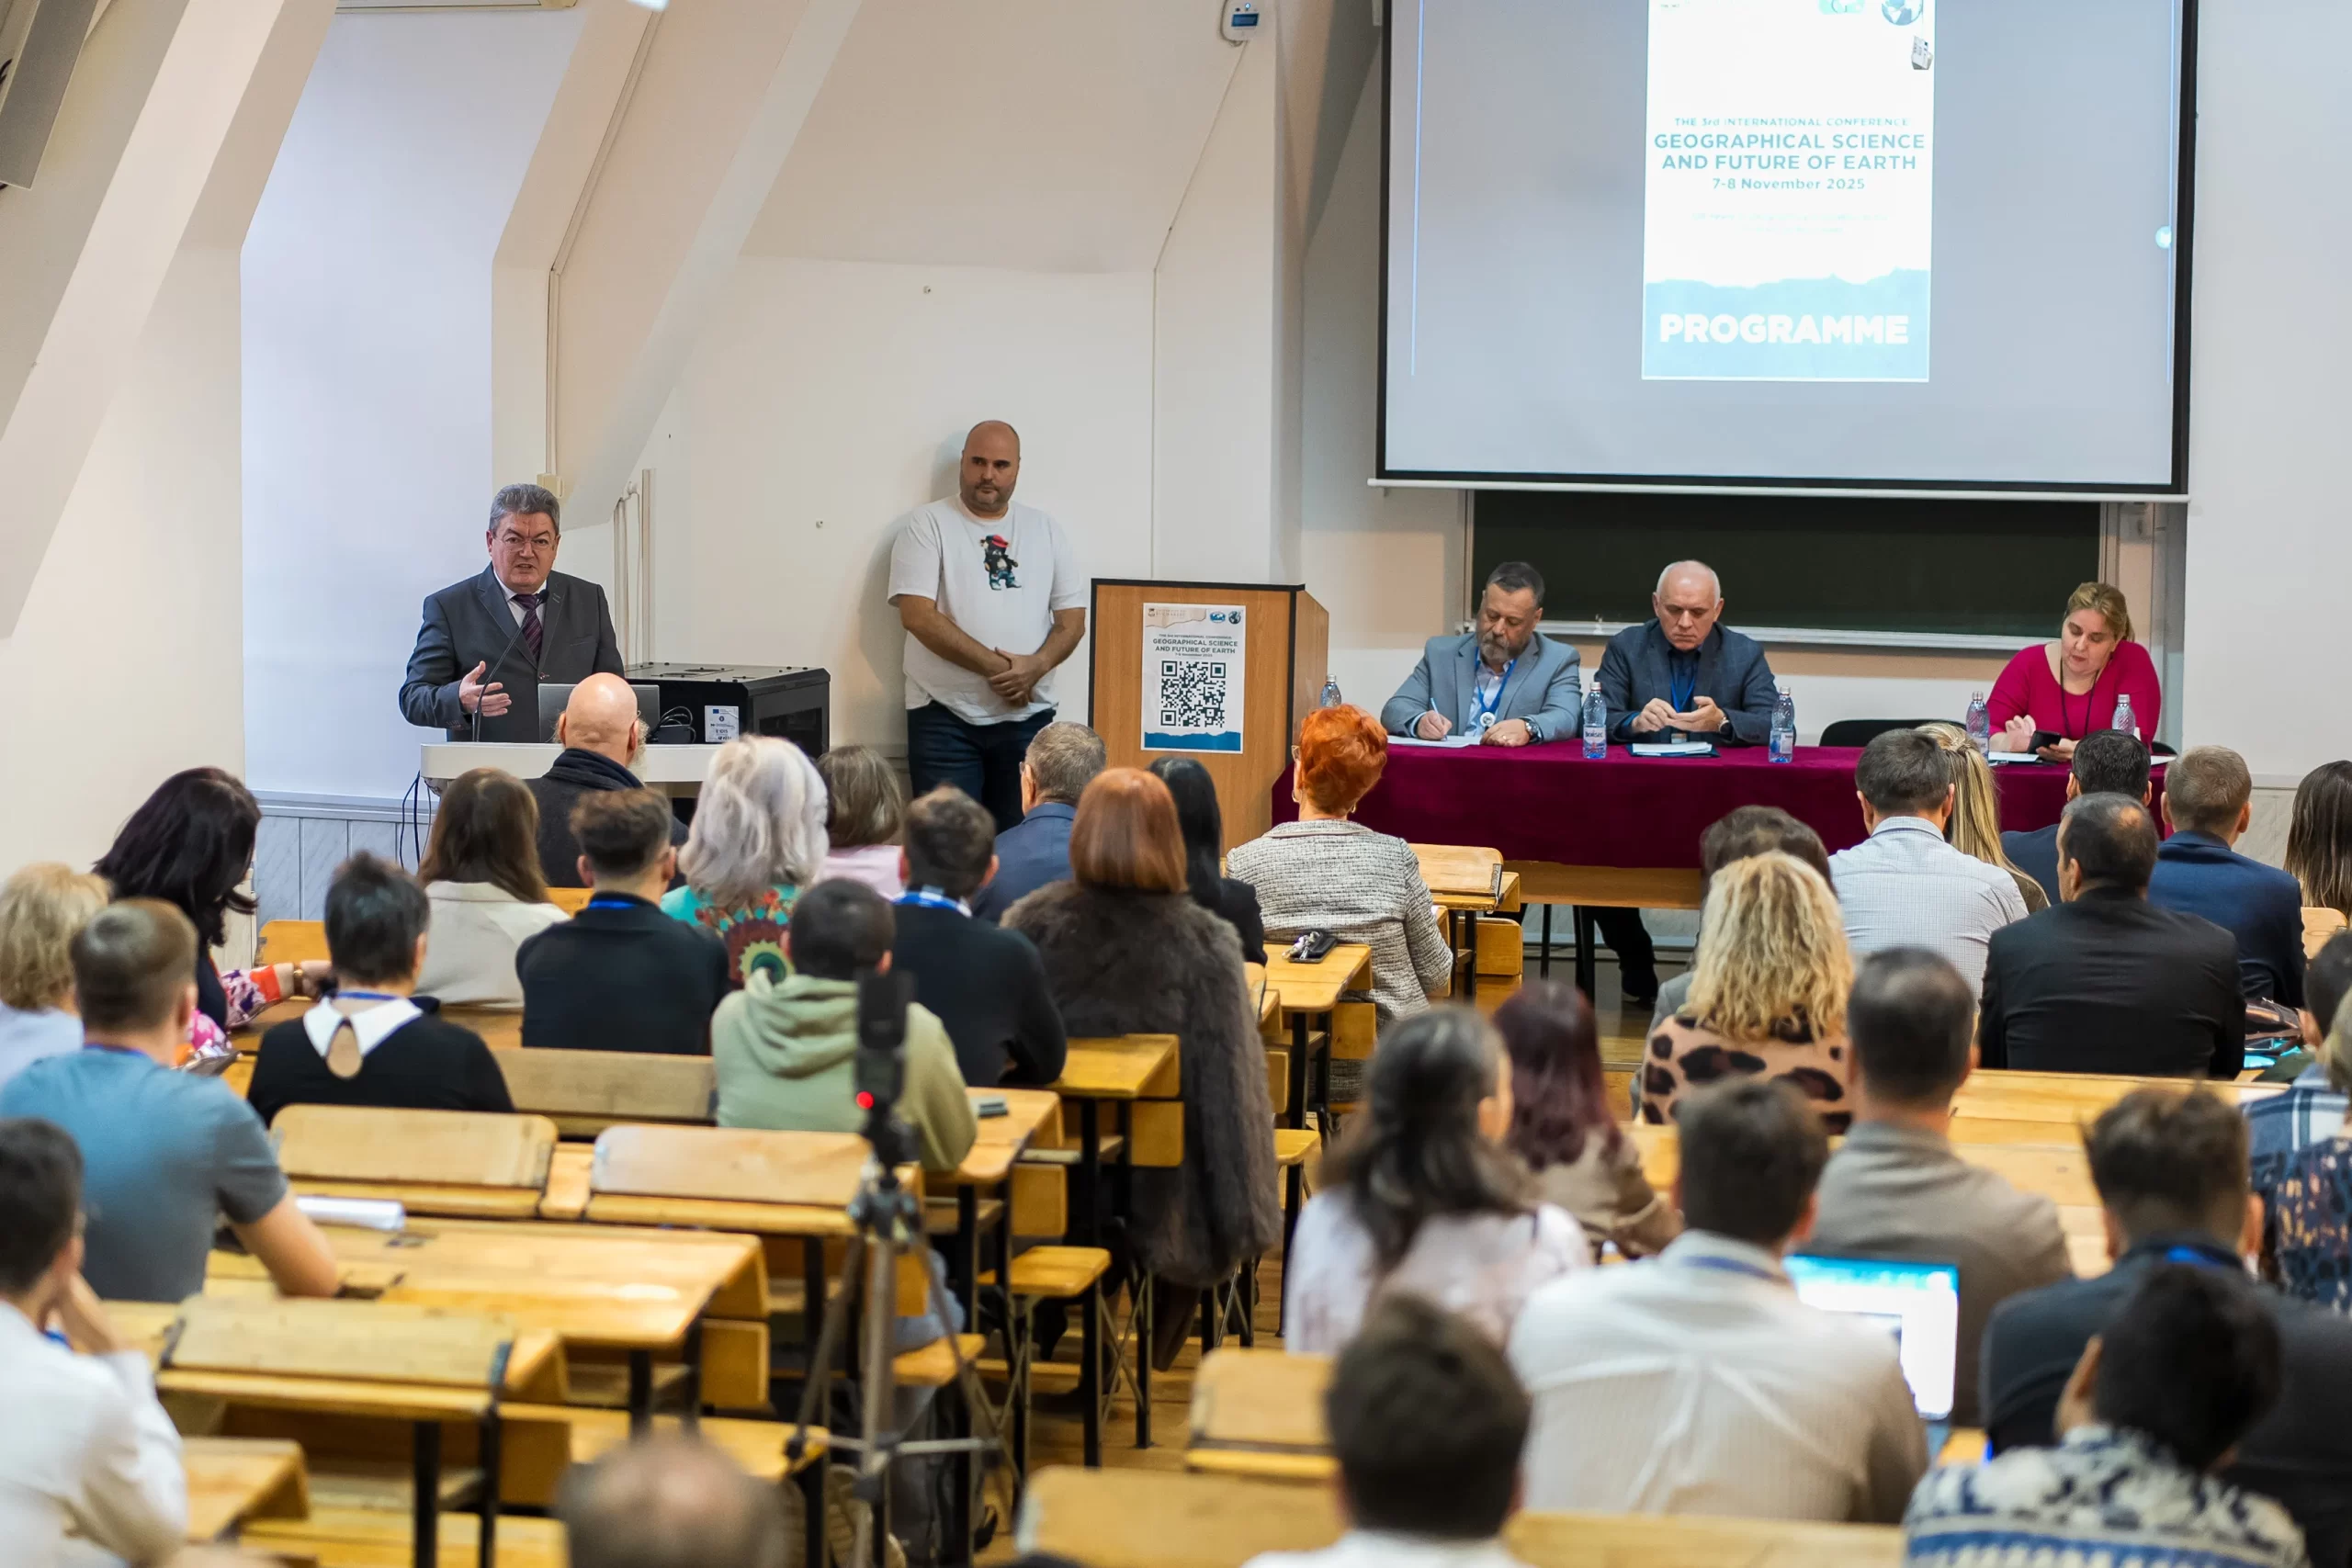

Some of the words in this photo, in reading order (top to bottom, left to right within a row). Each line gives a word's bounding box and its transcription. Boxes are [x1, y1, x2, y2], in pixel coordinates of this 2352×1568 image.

[1675, 118, 1697, 127] THE
[1702, 118, 1720, 127] 3rd
[1724, 118, 1822, 127] INTERNATIONAL
[1826, 118, 1910, 127] CONFERENCE
[1654, 133, 1825, 150] GEOGRAPHICAL
[1832, 133, 1925, 150] SCIENCE
[1662, 154, 1708, 170] AND
[1715, 154, 1800, 170] FUTURE
[1807, 154, 1836, 170] OF
[1844, 154, 1917, 170] EARTH
[1713, 178, 1736, 189] 7-8
[1741, 178, 1821, 189] November
[1826, 178, 1865, 189] 2025
[1659, 314, 1908, 344] PROGRAMME
